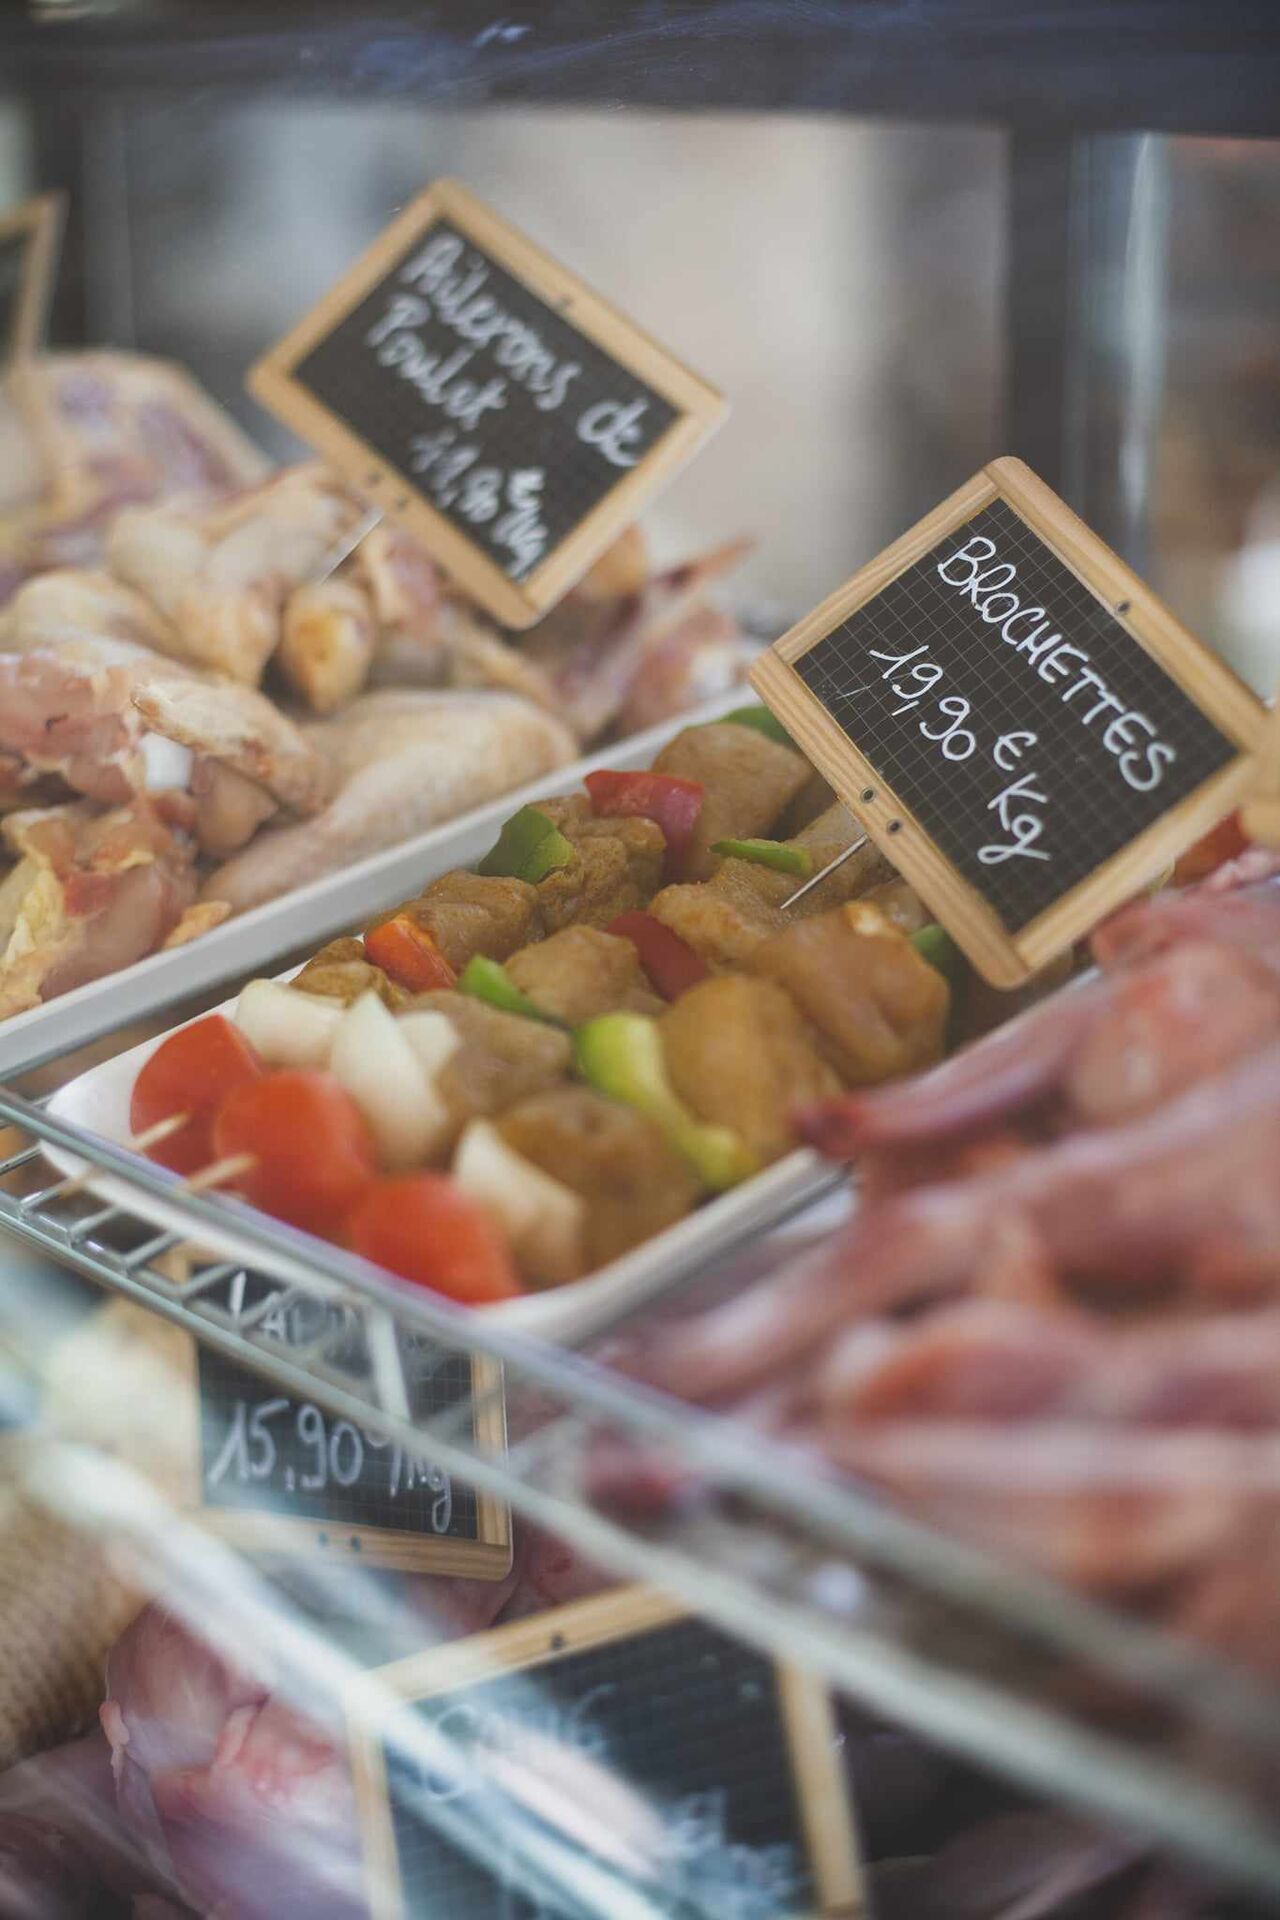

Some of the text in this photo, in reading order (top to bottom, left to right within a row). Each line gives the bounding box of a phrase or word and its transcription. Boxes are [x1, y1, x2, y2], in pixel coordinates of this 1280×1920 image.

[365, 292, 508, 431] Poulet
[577, 396, 649, 468] de
[937, 536, 1176, 792] BROCHETTES
[869, 645, 1051, 865] 19,90 € Kg
